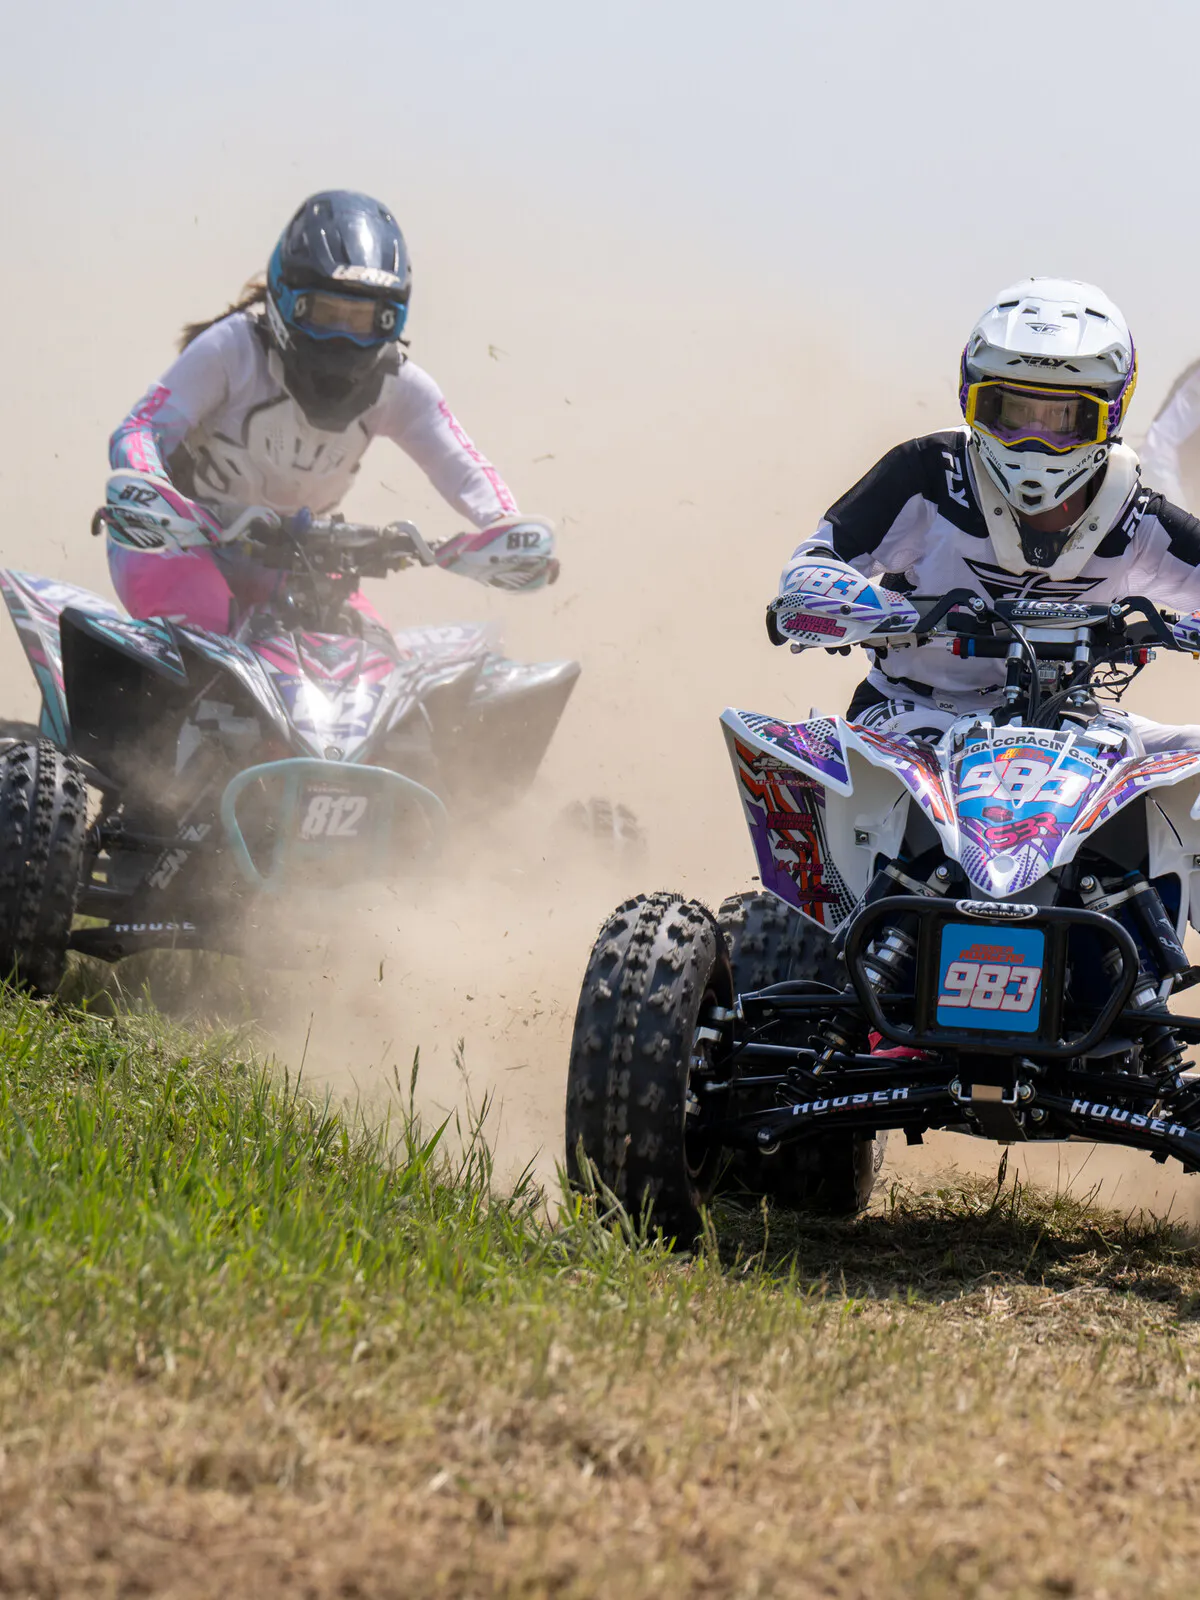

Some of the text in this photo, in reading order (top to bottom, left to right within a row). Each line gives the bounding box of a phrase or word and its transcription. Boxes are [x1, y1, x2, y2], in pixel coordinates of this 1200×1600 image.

[942, 451, 970, 509] FLY
[506, 532, 541, 550] 812
[783, 566, 869, 603] 983
[955, 758, 1090, 808] 983
[302, 795, 368, 836] 812
[968, 909, 1025, 917] RACING
[938, 961, 1042, 1013] 983
[792, 1087, 909, 1115] HOUSER
[1070, 1098, 1188, 1137] HOUSER
